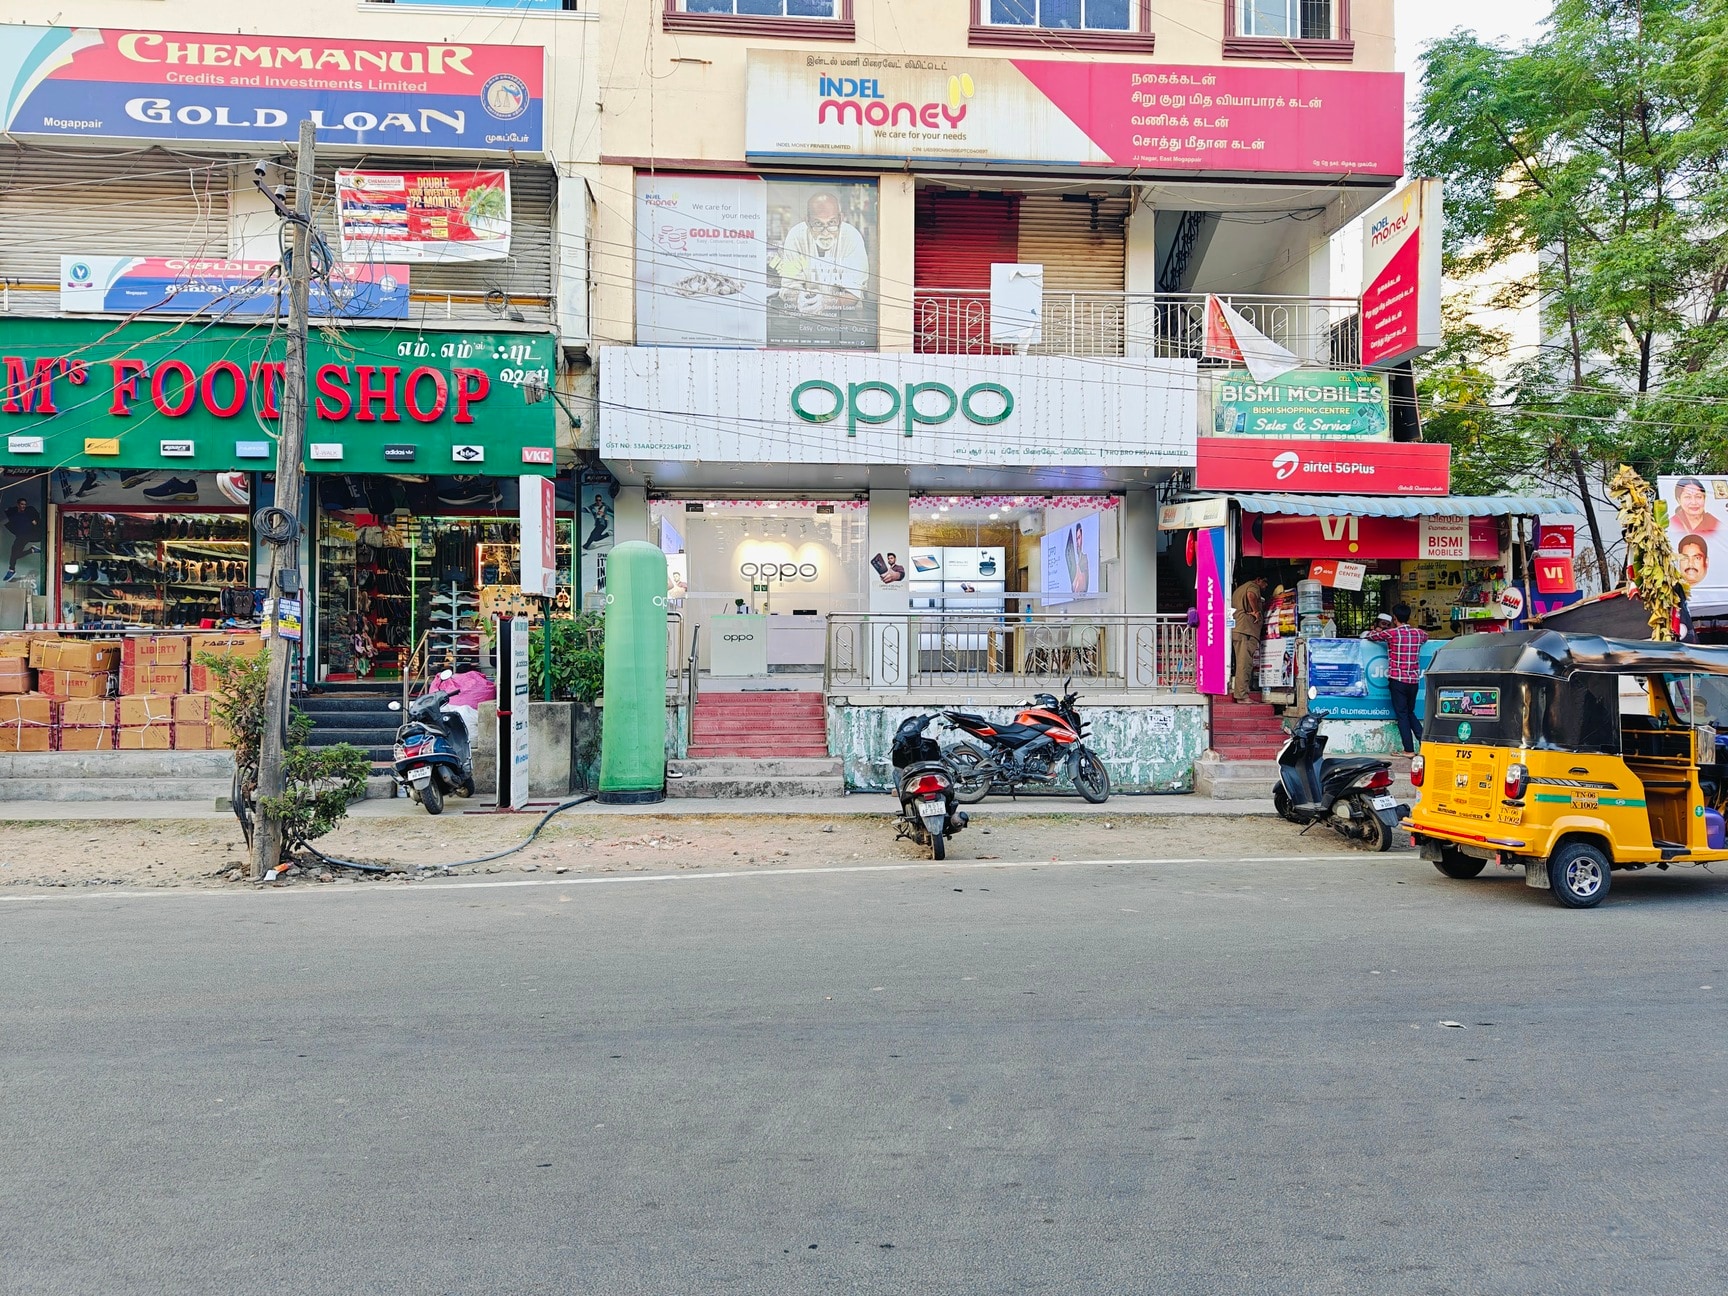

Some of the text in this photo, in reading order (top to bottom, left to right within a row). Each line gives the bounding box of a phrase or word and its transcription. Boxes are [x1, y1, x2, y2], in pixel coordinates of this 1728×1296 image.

[117, 33, 475, 76] CHEMMANUR
[807, 55, 838, 67] இன்டல்
[841, 57, 859, 67] மணி
[166, 71, 427, 93] Credits and Investments Limited
[1131, 72, 1216, 86] நகைக்கடன்
[1131, 91, 1322, 109] சிறு குறு மித வியாபாரக் கடன்
[125, 98, 465, 135] GOLD LOAN
[1131, 114, 1229, 128] வணிகக் கடன்
[43, 117, 103, 130] Mogappair
[485, 133, 529, 144] முகப்பேர்
[874, 130, 967, 143] We care for your needs
[1132, 135, 1265, 151] சொத்து மீதான கடன்
[417, 176, 450, 189] DOUBLE
[408, 188, 423, 197] YOUR
[410, 195, 461, 208] 72 MONTHS
[721, 203, 731, 211] for
[740, 212, 760, 220] needs
[690, 228, 755, 240] GOLD LOAN
[109, 357, 288, 419] FOOT
[316, 364, 491, 423] SHOP
[1222, 385, 1383, 403] BISMI MOBILES
[1253, 406, 1274, 414] BISMI
[1319, 407, 1350, 415] CENTRE
[1253, 416, 1351, 432] Sales & Service
[525, 451, 550, 461] VKC
[1303, 460, 1332, 473] airtel
[1428, 536, 1463, 547] BISMI
[1428, 549, 1463, 557] MOBILES
[1338, 570, 1361, 579] CENTRE
[1503, 594, 1520, 607] SUN
[1456, 750, 1472, 759] TVS
[1580, 802, 1598, 810] 1002
